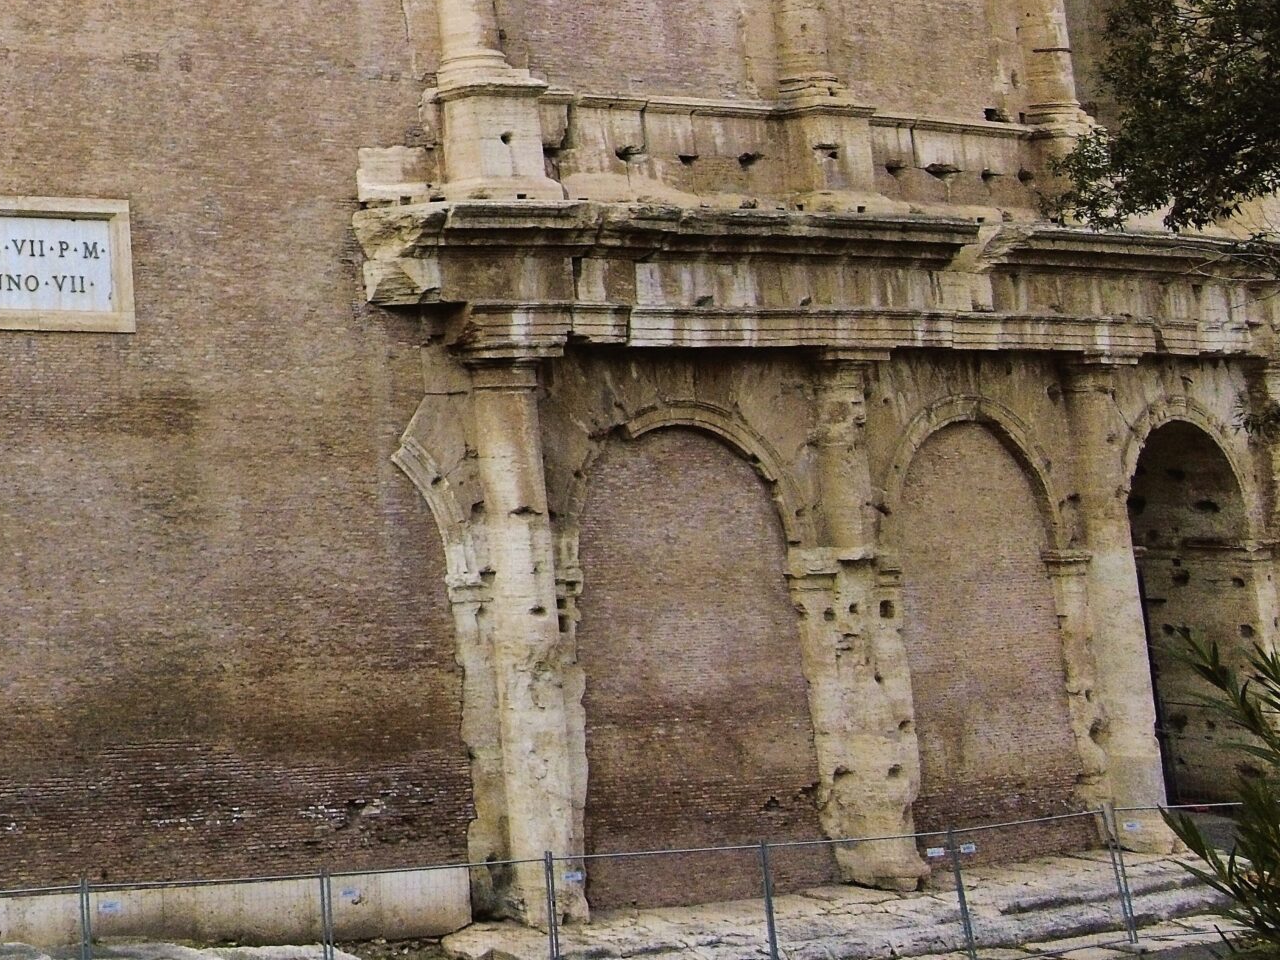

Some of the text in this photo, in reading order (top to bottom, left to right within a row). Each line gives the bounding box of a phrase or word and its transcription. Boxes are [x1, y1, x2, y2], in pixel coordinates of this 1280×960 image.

[12, 239, 45, 257] VII
[58, 241, 69, 258] P
[82, 242, 100, 259] M
[52, 275, 86, 293] VII
